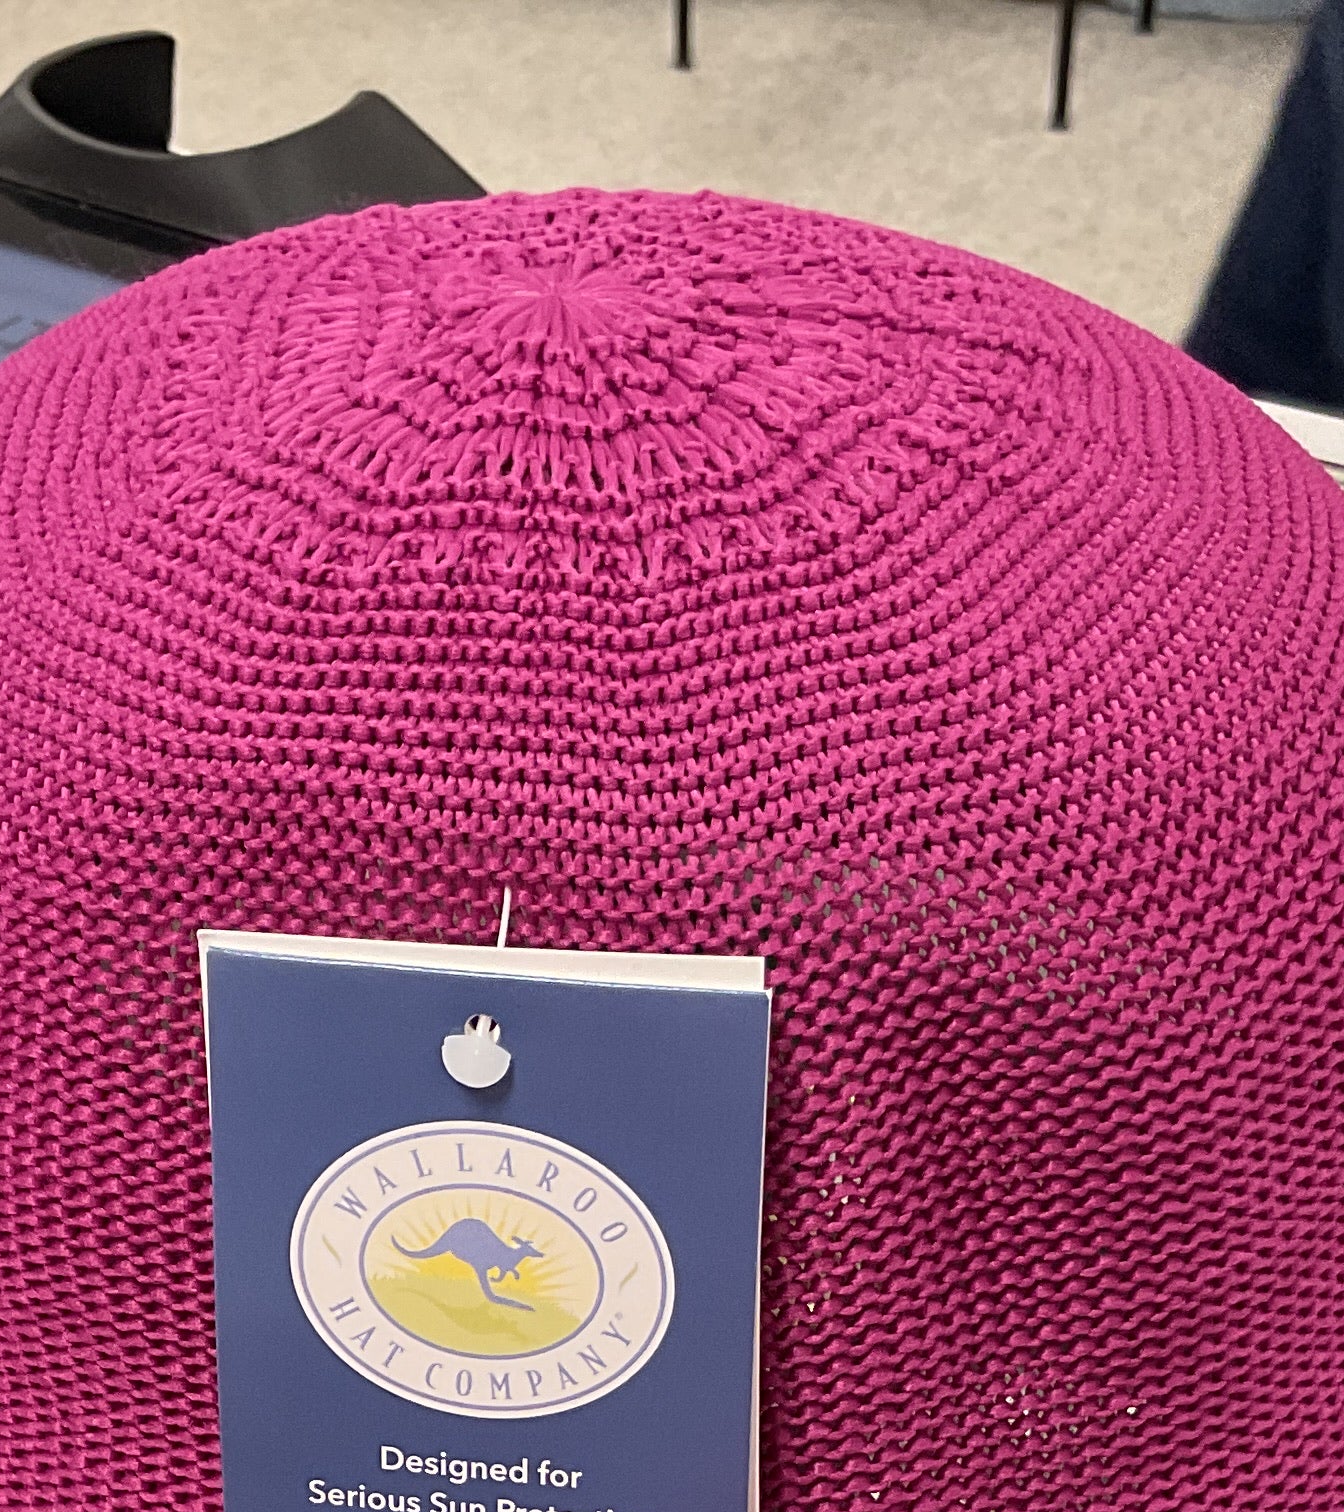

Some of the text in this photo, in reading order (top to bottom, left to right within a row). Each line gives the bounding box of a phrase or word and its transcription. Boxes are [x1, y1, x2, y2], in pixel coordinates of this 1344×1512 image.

[333, 1142, 629, 1244] WALLAROO
[328, 1296, 632, 1400] HAT COMPANY
[379, 1445, 583, 1489] Designed for
